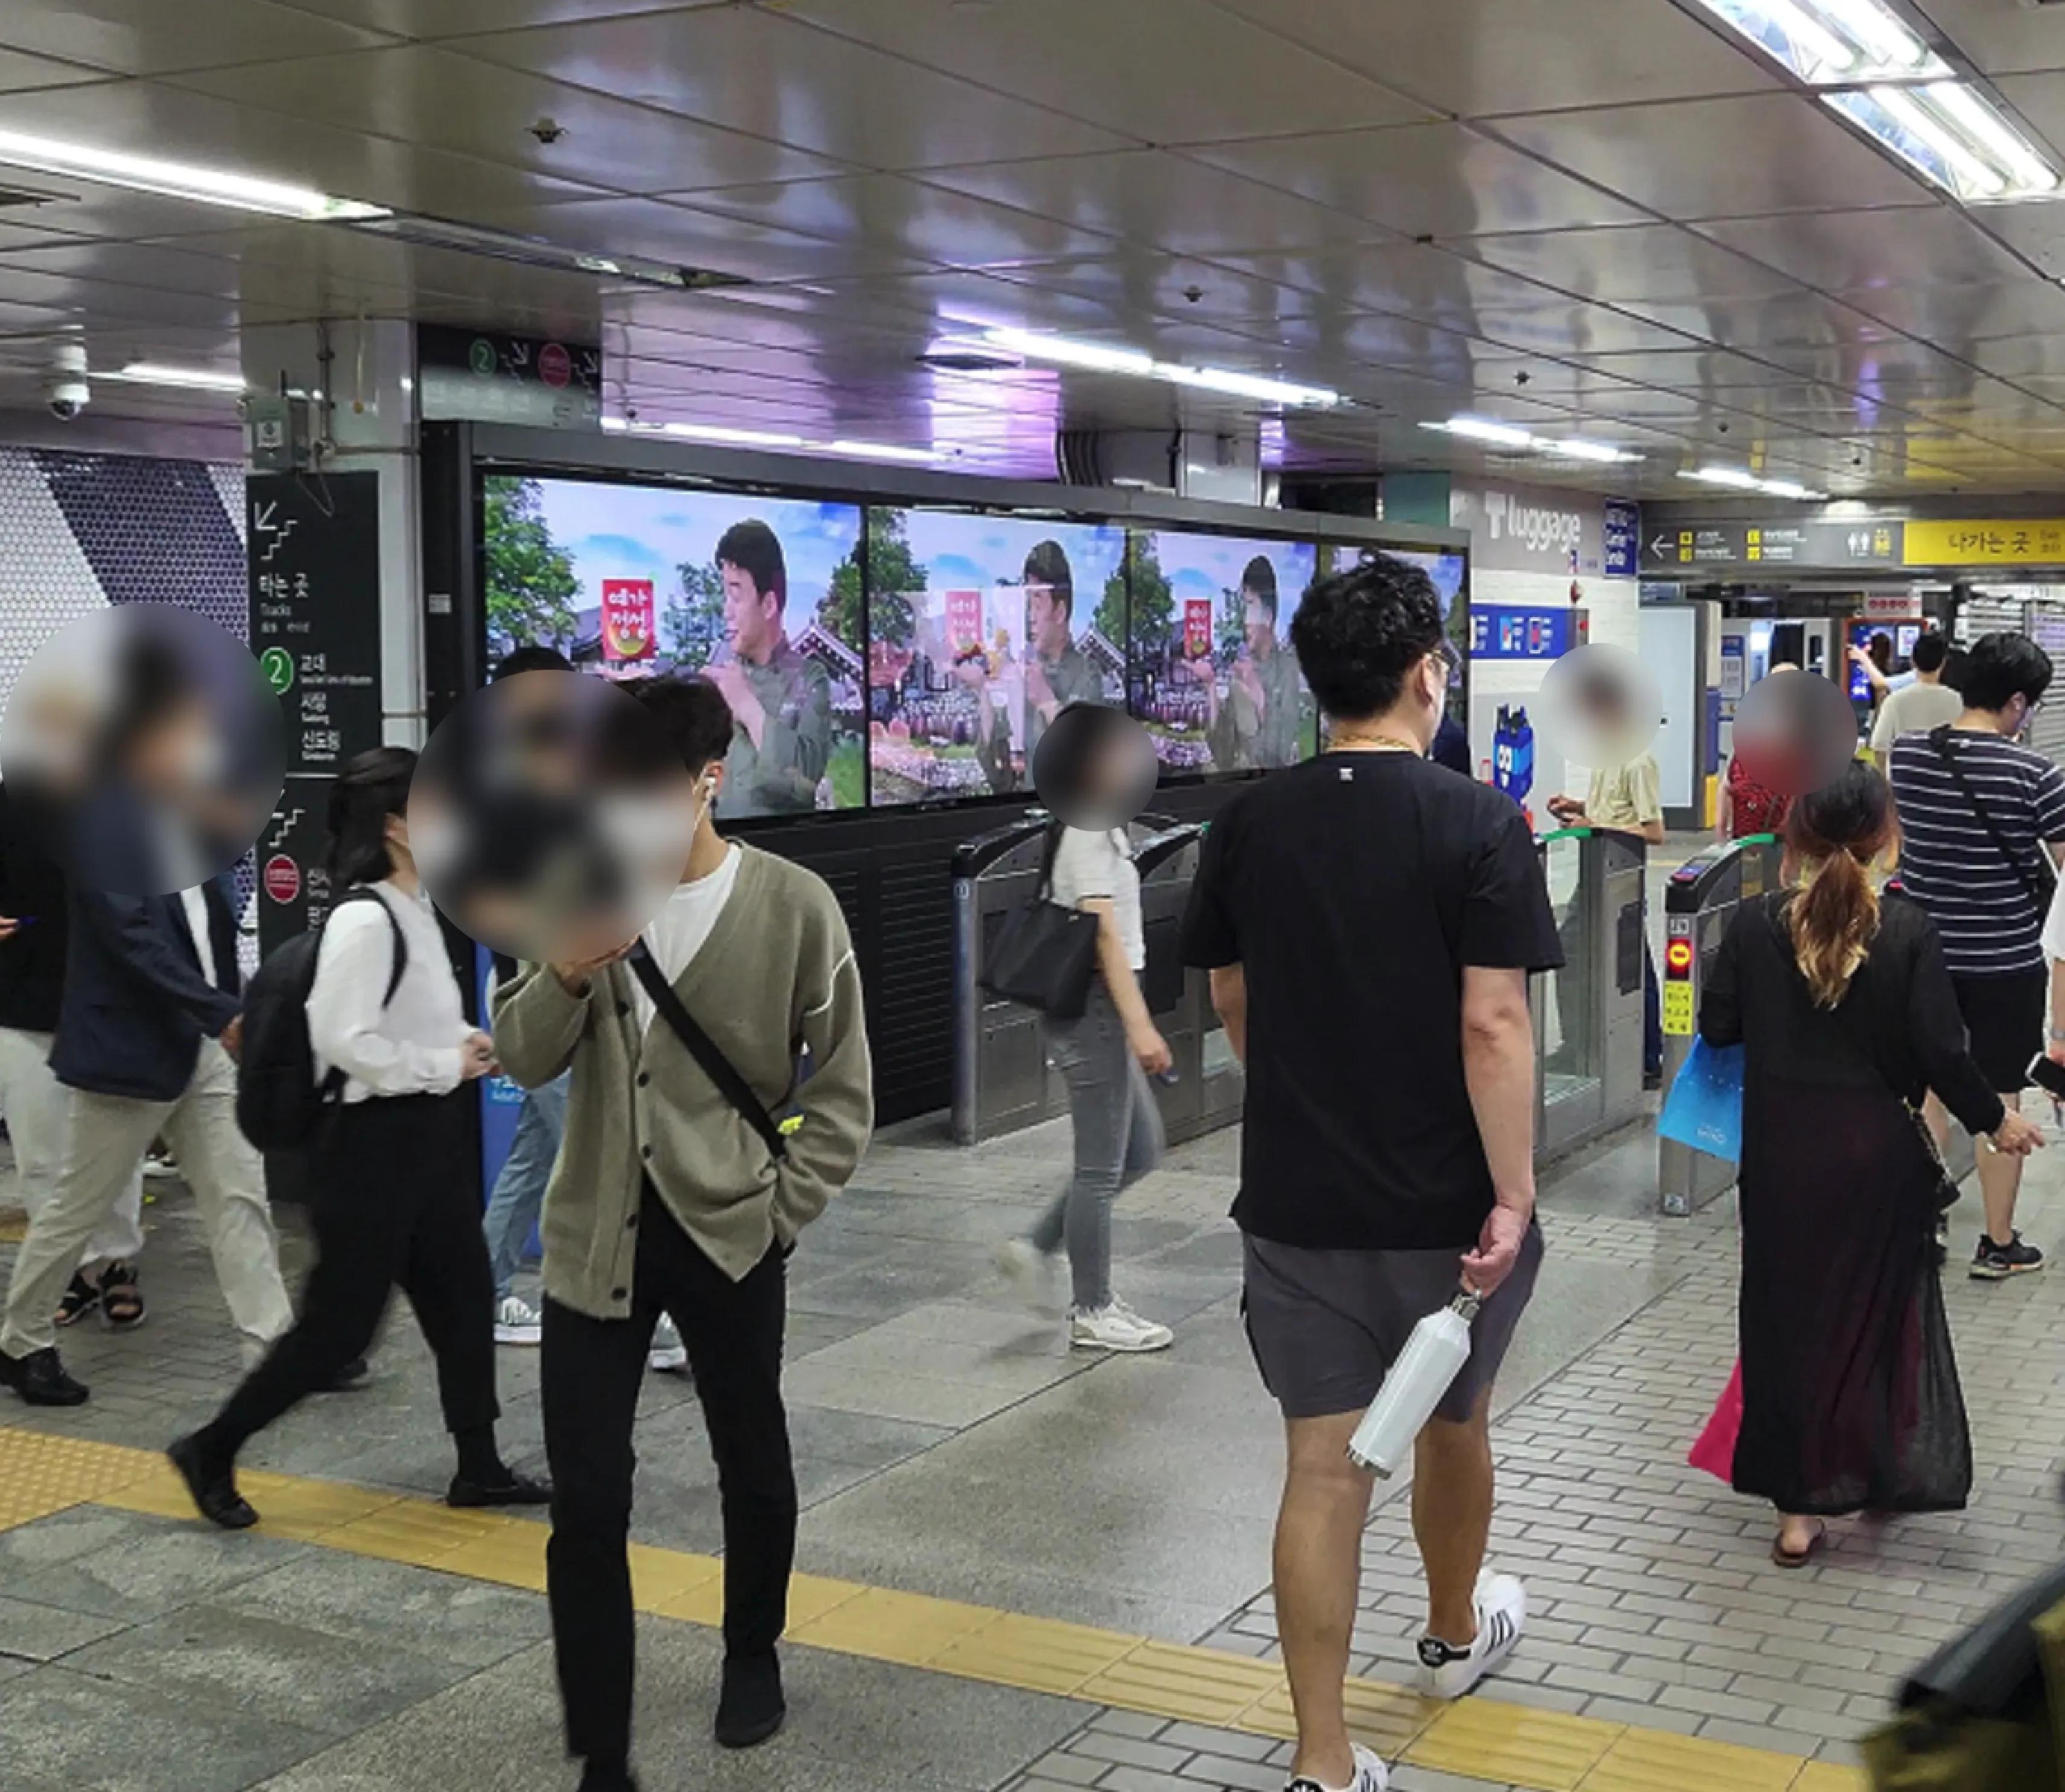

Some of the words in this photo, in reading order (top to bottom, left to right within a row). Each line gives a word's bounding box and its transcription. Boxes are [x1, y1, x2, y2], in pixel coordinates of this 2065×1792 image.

[1508, 494, 1581, 554] luggage
[1949, 531, 2006, 554] 나가는
[2012, 531, 2031, 554] 곳
[259, 572, 290, 599] 타는
[293, 571, 309, 599] 곳
